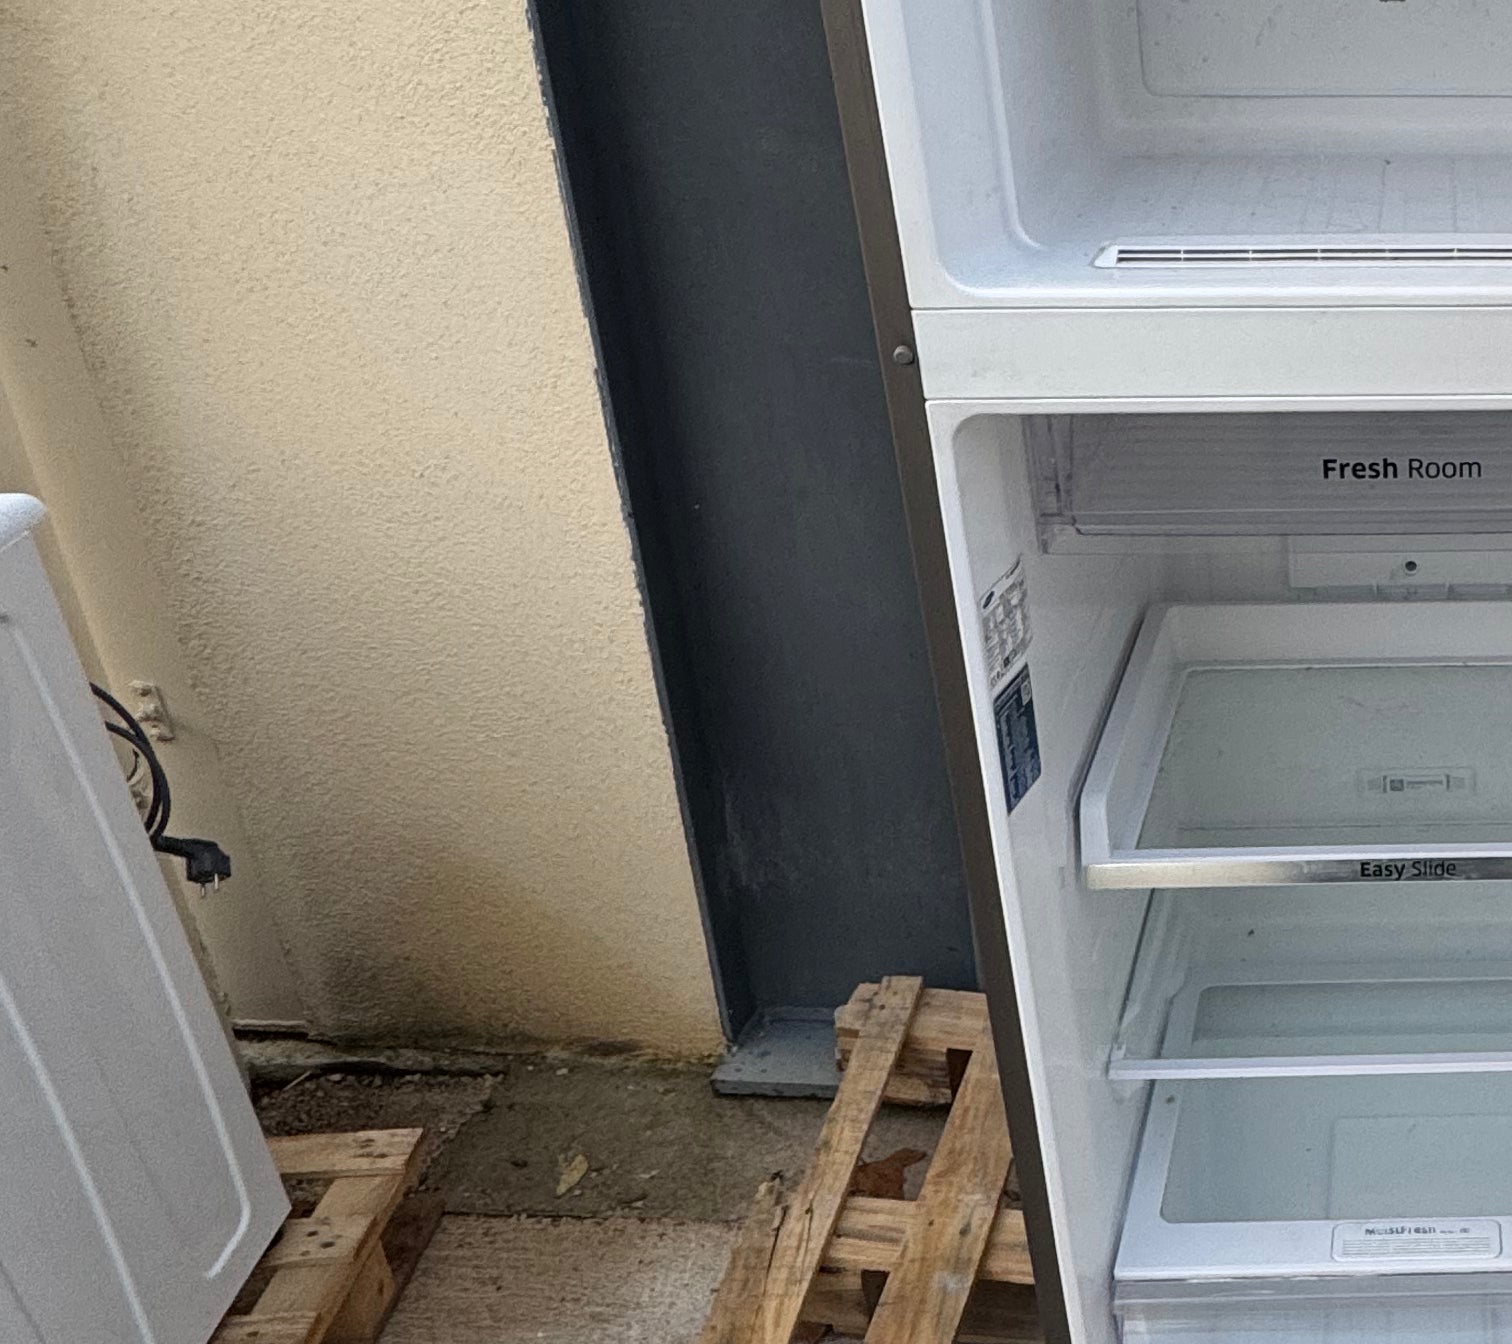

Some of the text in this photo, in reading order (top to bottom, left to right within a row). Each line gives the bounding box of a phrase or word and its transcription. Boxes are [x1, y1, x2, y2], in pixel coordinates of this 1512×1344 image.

[1322, 458, 1482, 479] Fresh Room
[1360, 860, 1457, 880] Easy Slide
